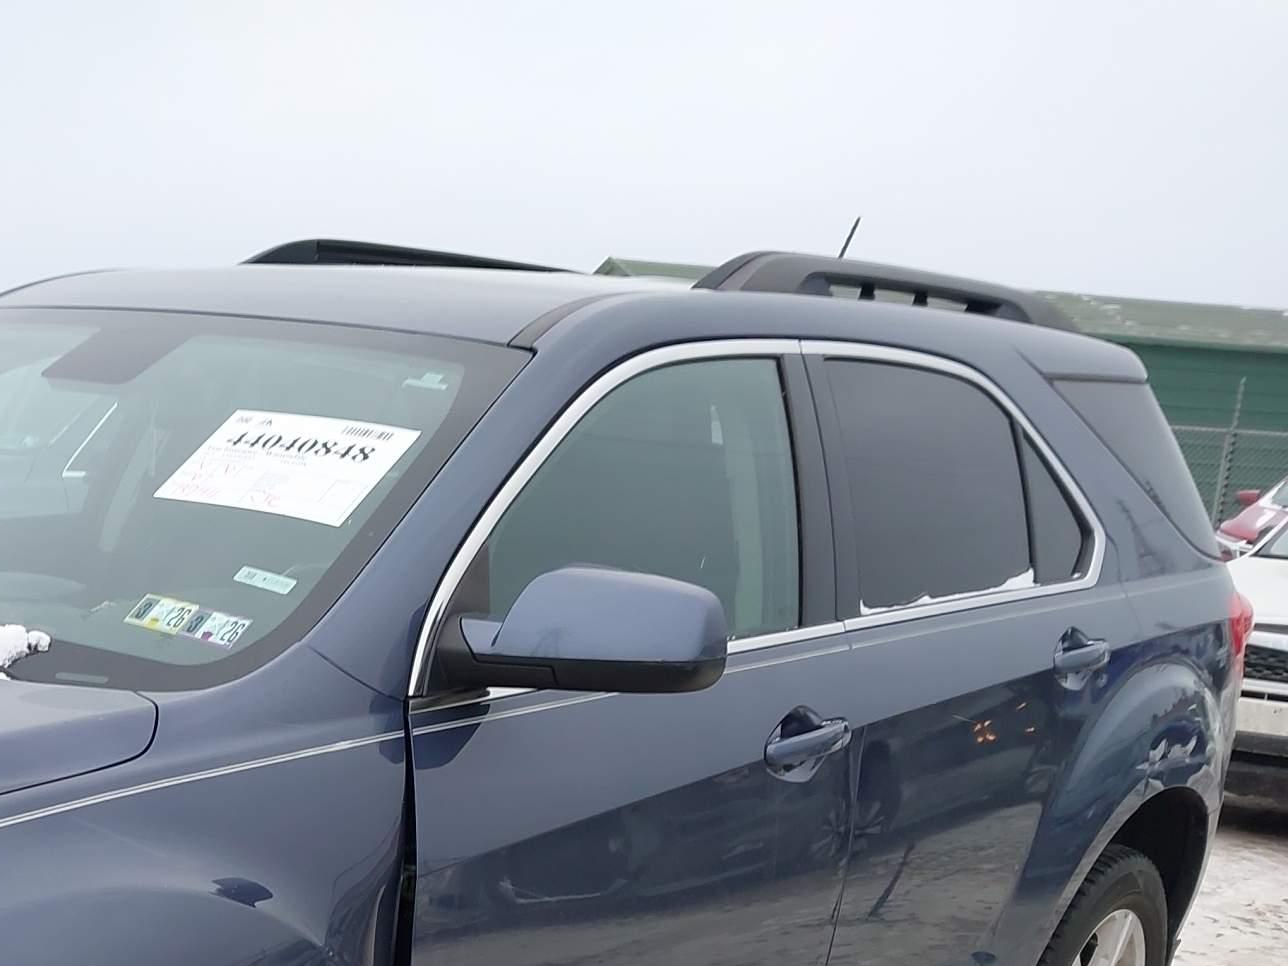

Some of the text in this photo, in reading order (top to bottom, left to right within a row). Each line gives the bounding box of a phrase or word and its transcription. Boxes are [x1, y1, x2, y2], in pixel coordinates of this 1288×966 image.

[226, 431, 376, 464] 44040848
[134, 601, 154, 620] 3
[186, 615, 205, 634] 3
